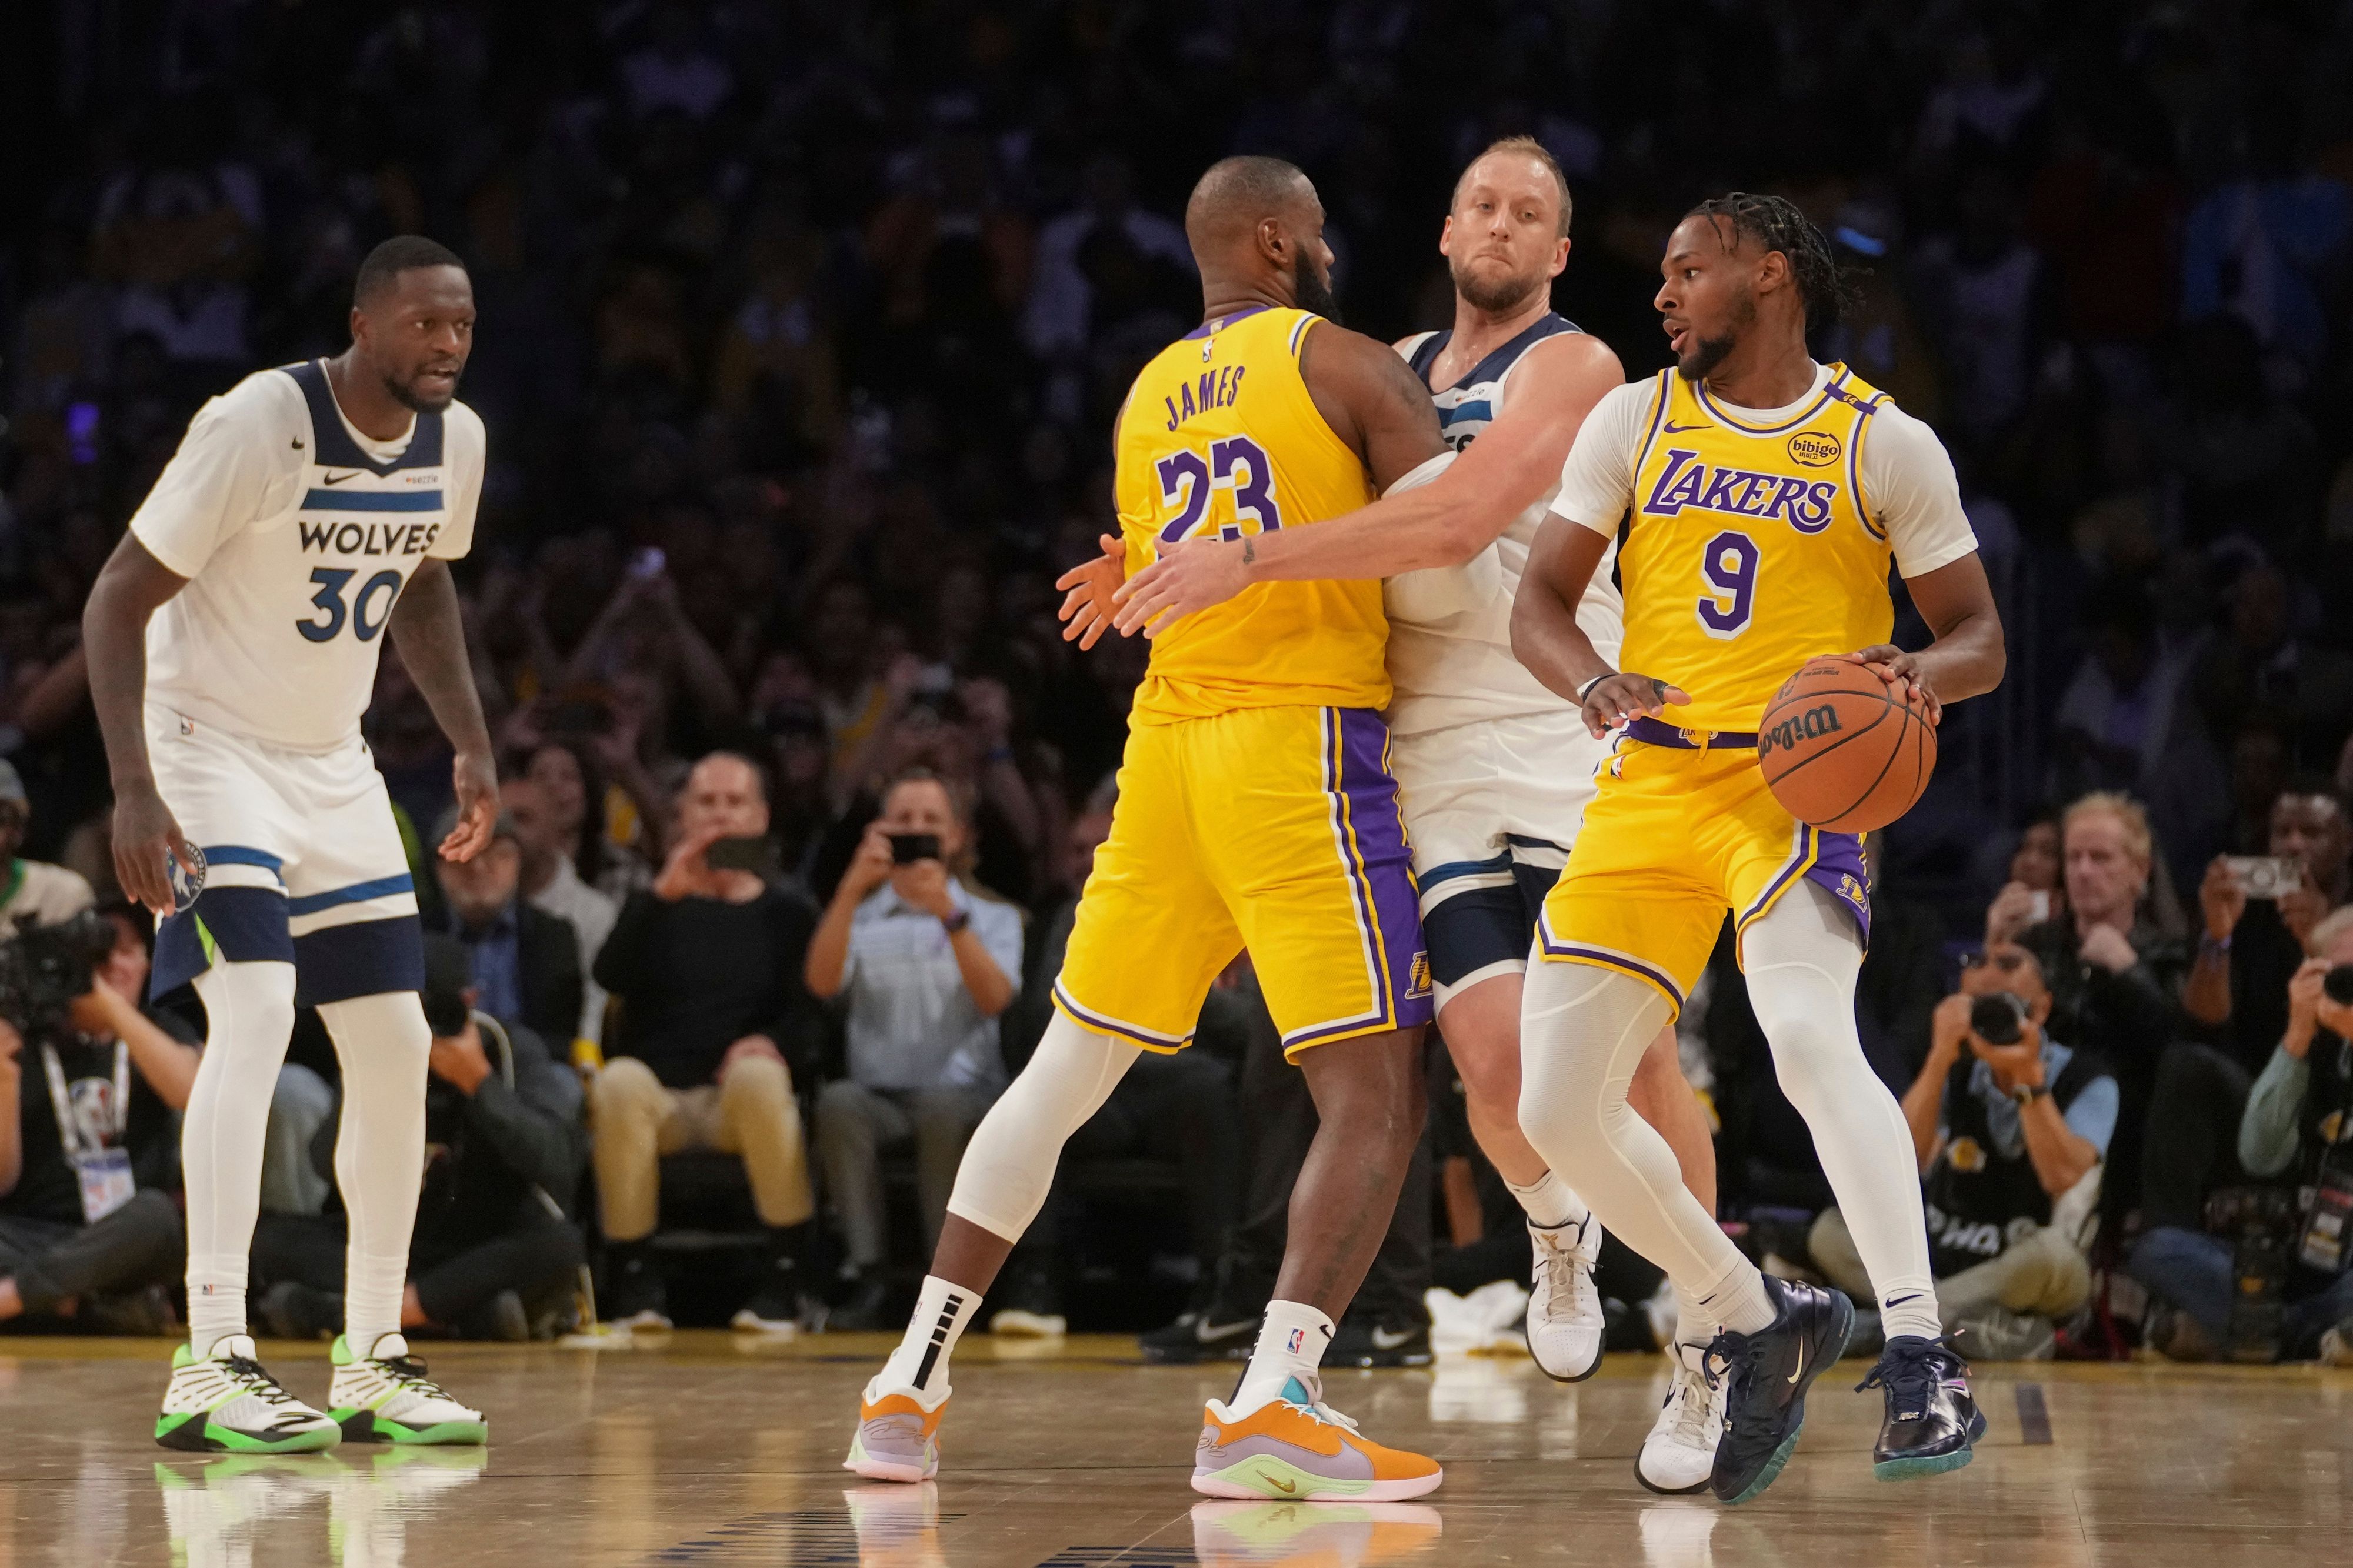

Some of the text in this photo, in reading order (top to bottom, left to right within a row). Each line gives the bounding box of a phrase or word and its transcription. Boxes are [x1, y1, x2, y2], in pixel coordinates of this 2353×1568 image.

[1165, 365, 1246, 432] JAMES
[1792, 439, 1838, 458] bibigo
[1799, 451, 1818, 460] 비비고
[1154, 432, 1283, 558] 23
[1642, 447, 1839, 536] LAKERS
[299, 521, 441, 555] WOLVES
[295, 566, 404, 644] 30
[1695, 529, 1761, 641] 9
[1759, 703, 1843, 761] Wilson
